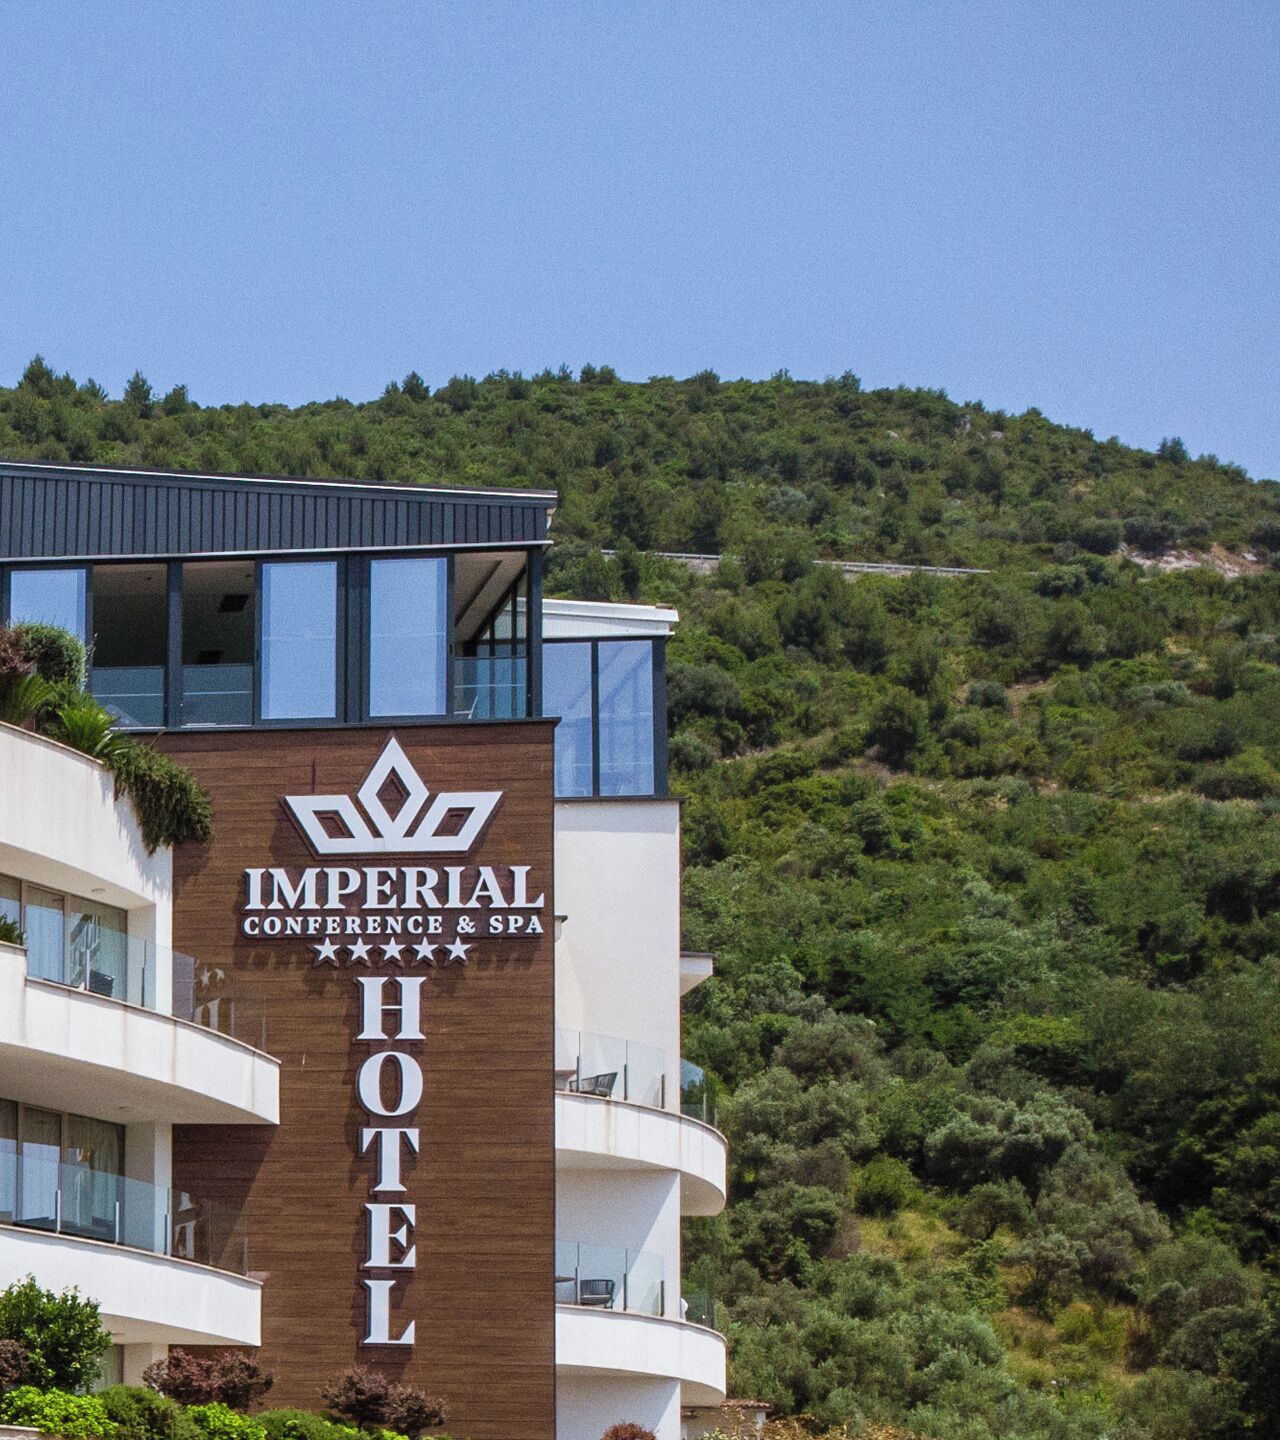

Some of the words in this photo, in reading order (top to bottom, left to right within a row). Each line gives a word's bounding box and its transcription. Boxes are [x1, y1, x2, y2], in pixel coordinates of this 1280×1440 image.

[244, 866, 545, 910] IMPERIAL
[243, 915, 443, 936] CONFERENCE
[456, 915, 476, 934] &
[489, 915, 544, 935] SPA
[356, 976, 427, 1346] HOTEL
